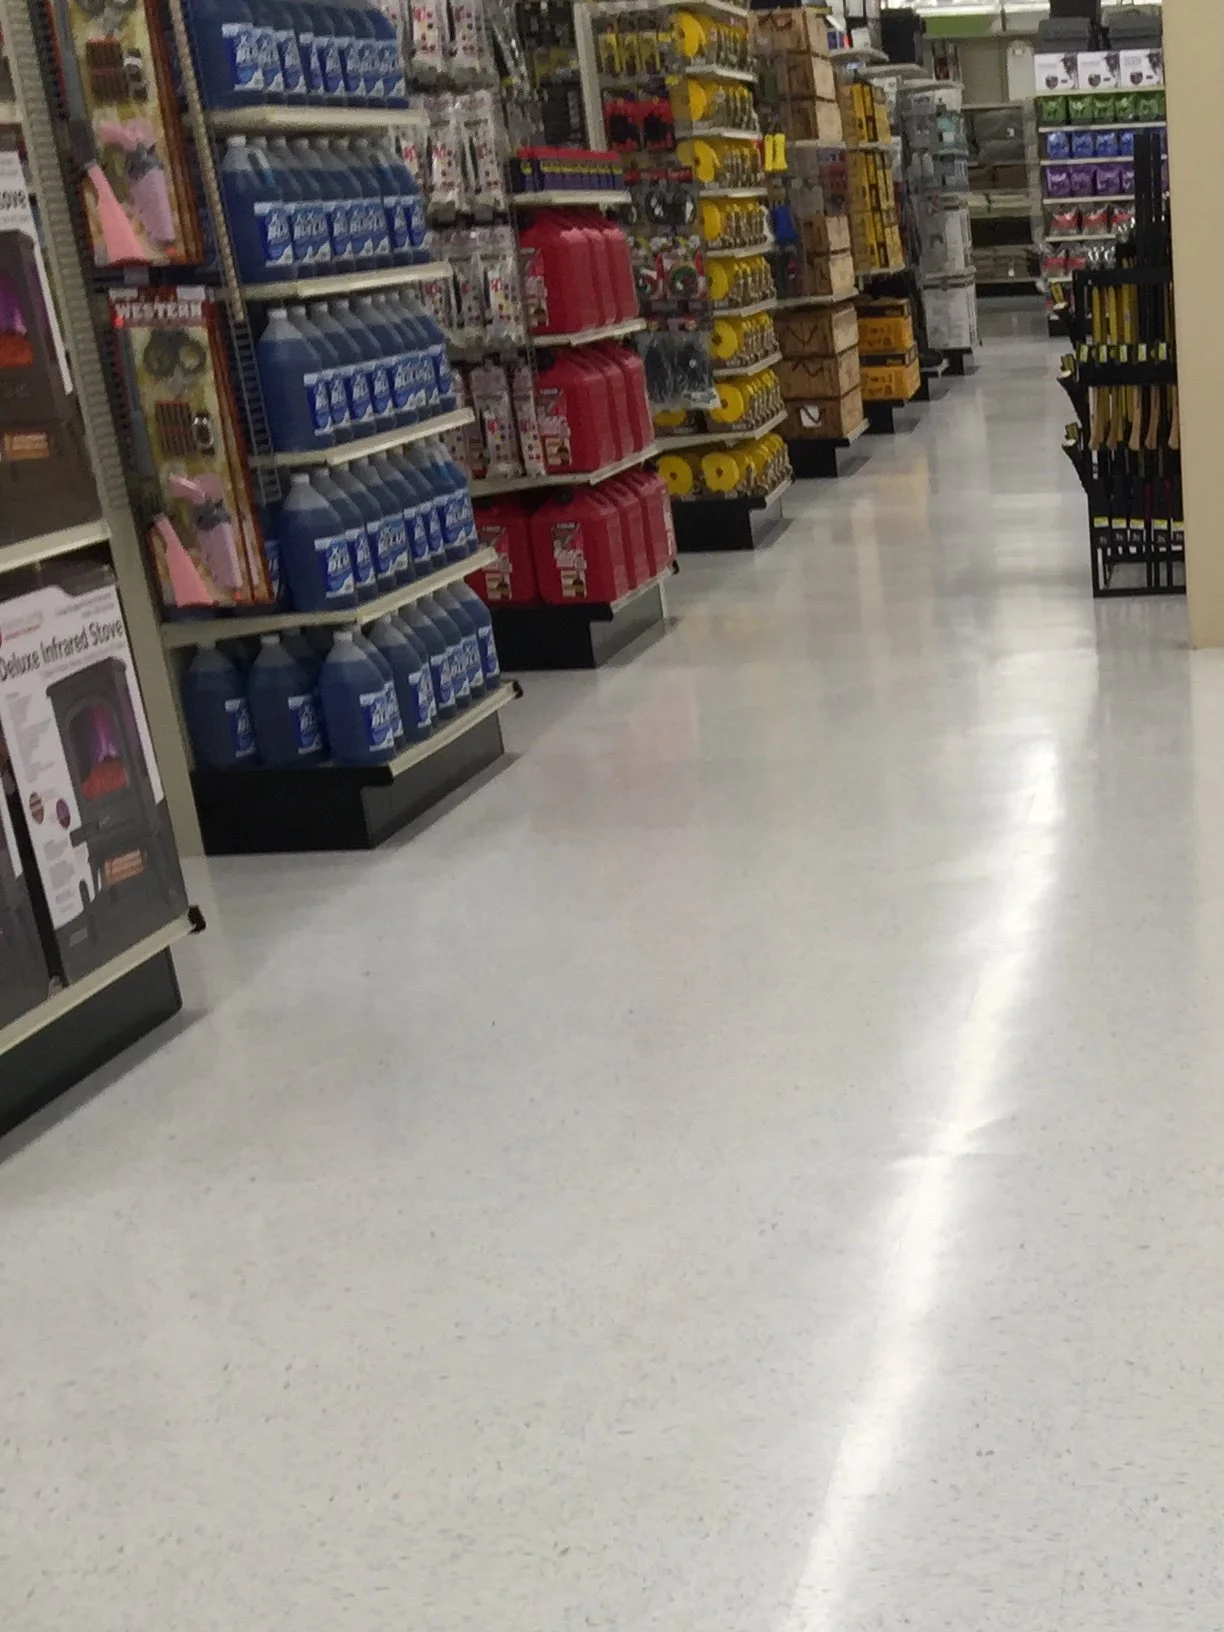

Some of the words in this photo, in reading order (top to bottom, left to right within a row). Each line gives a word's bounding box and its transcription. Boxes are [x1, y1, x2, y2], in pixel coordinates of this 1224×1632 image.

[115, 301, 202, 319] WESTERN
[0, 651, 41, 681] Deluxe
[40, 624, 89, 664] Infrared
[89, 619, 124, 646] Stove
